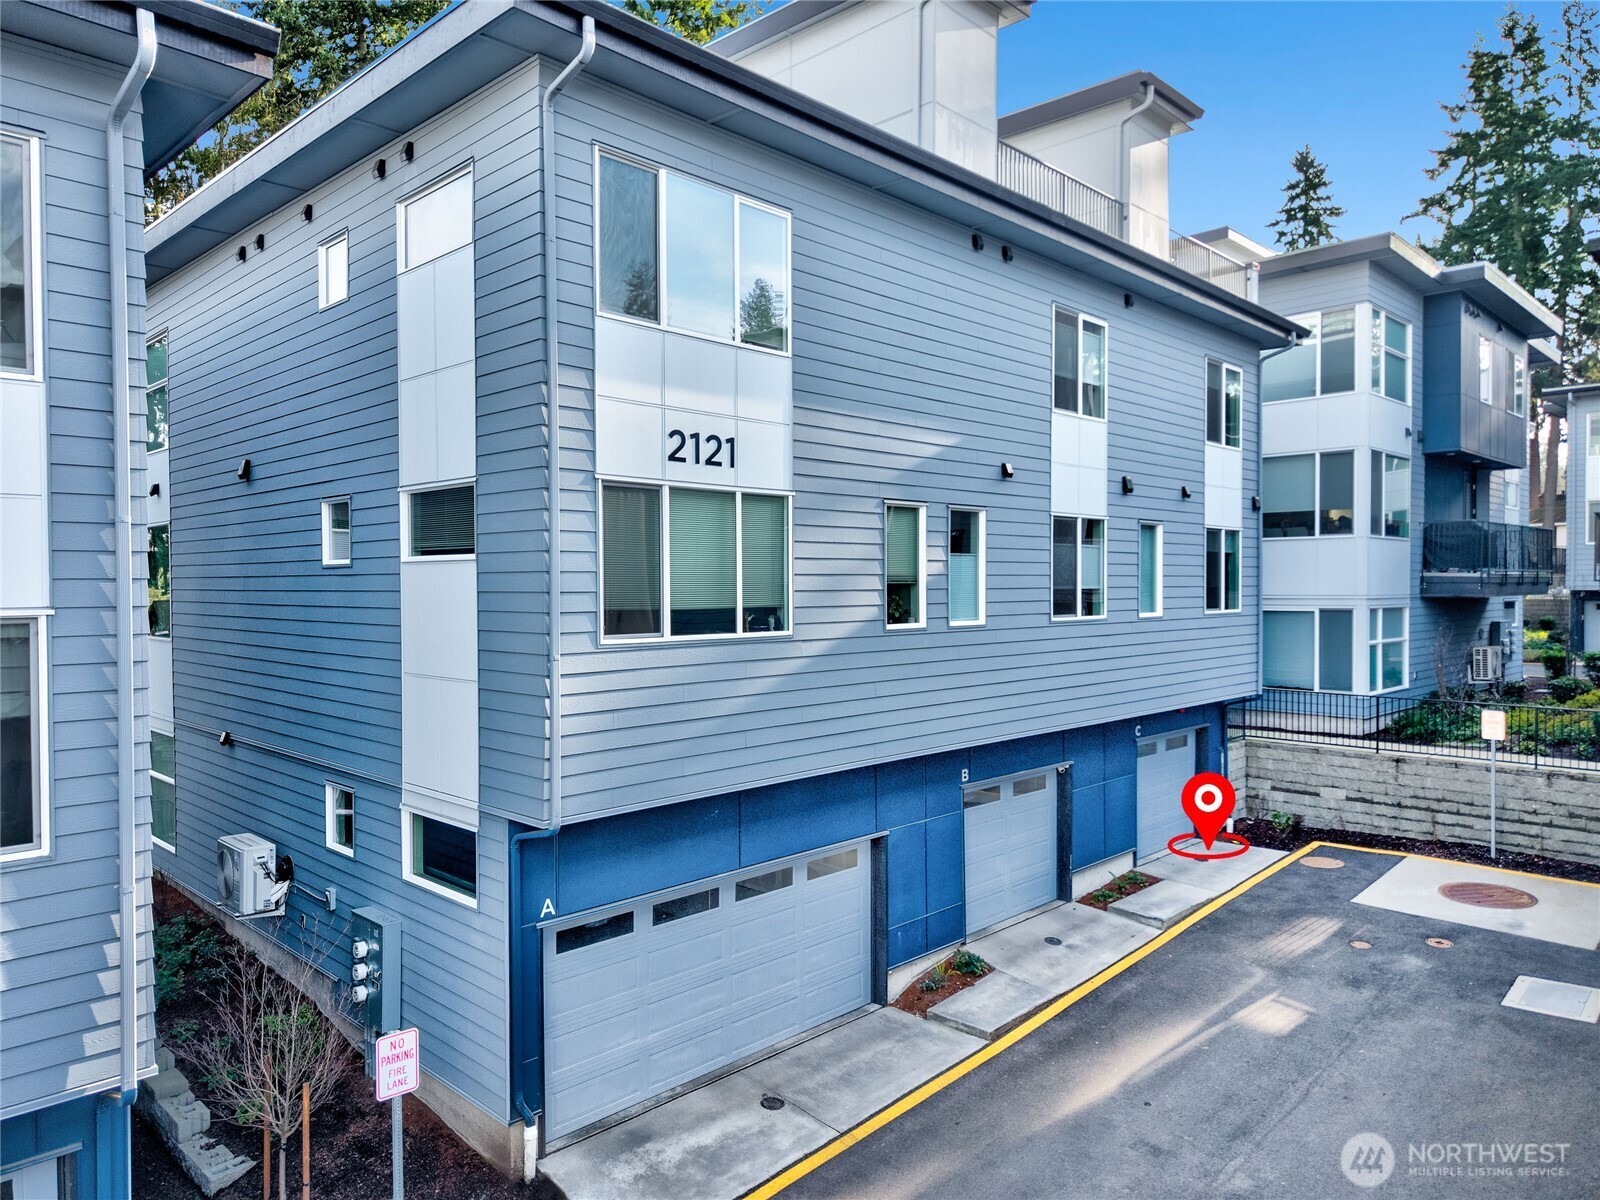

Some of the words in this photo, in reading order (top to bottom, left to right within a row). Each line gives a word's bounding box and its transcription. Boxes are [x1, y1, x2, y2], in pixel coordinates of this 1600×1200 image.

[667, 429, 735, 468] 2121
[1134, 725, 1141, 736] C
[961, 769, 969, 781] B
[540, 898, 556, 918] A
[389, 1038, 405, 1051] NO
[381, 1048, 414, 1067] PARKING
[388, 1065, 407, 1078] FIRE
[387, 1076, 408, 1090] LANE
